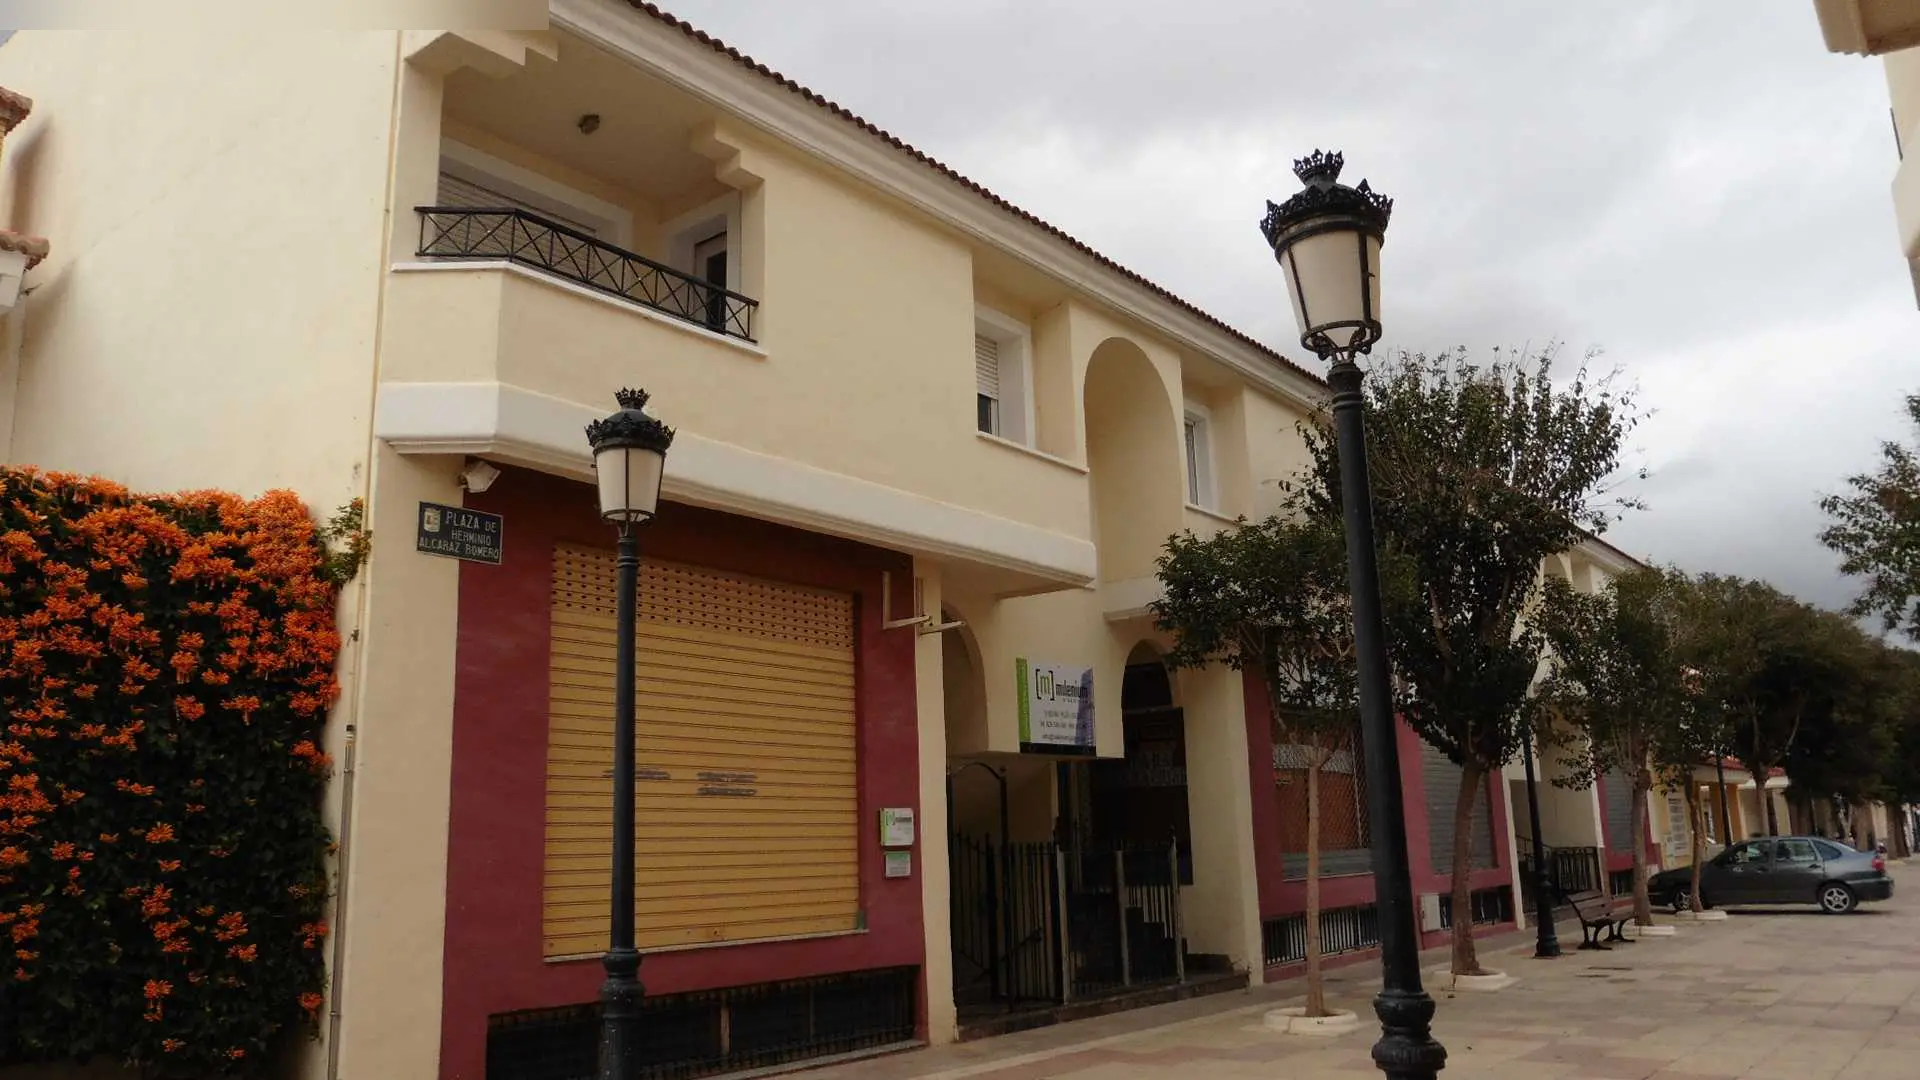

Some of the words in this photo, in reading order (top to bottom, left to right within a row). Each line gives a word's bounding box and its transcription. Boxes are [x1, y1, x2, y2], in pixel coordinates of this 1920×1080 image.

[445, 511, 480, 529] PLAZA
[484, 520, 497, 533] DE
[451, 527, 492, 546] HERMINIO
[419, 536, 461, 554] ALCARAZ
[465, 543, 499, 560] ROMERO
